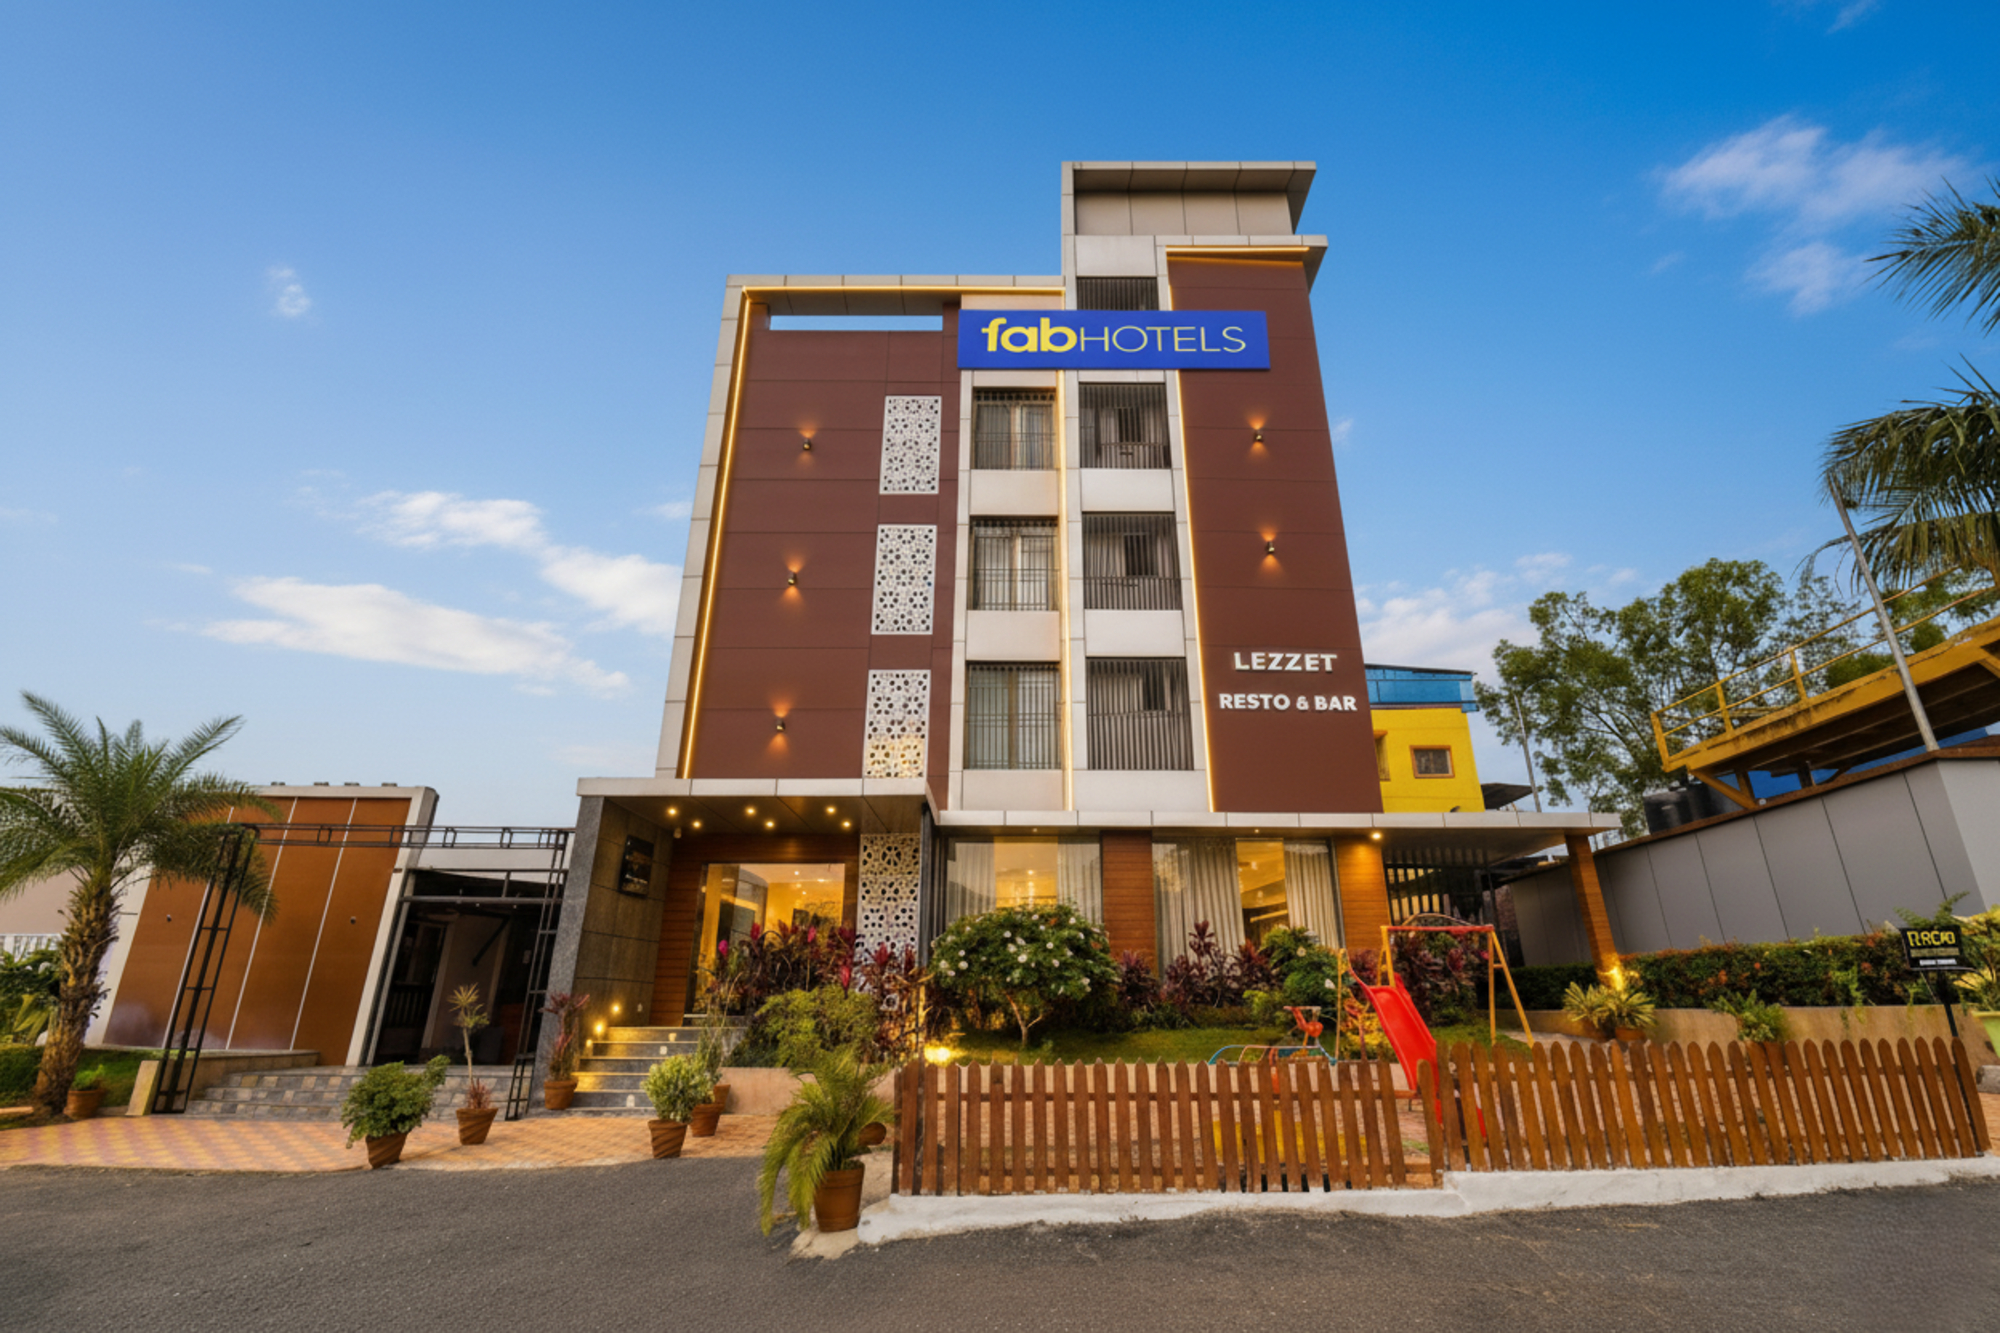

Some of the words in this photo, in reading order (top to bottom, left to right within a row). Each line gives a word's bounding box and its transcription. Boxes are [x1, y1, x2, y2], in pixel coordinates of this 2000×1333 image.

[1234, 652, 1338, 672] LEZZET
[1219, 693, 1291, 711] RESTO
[1296, 696, 1309, 711] &
[1314, 695, 1358, 711] BAR
